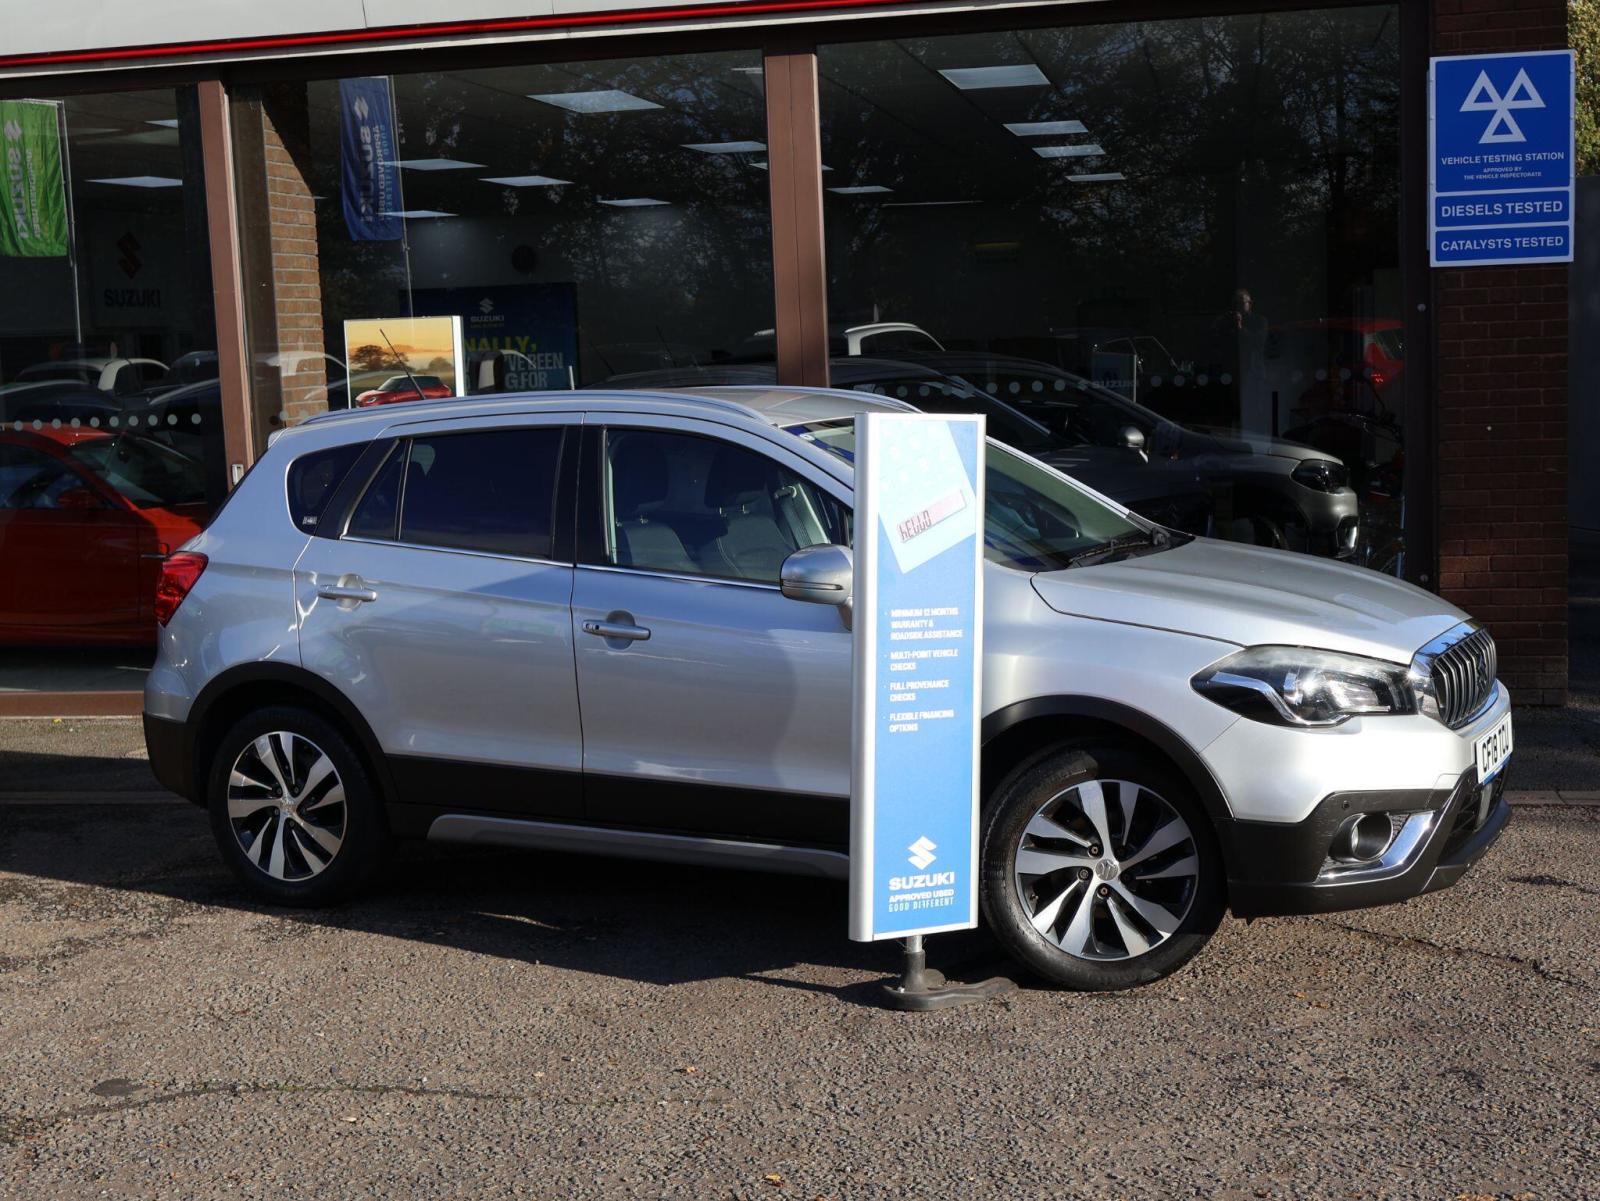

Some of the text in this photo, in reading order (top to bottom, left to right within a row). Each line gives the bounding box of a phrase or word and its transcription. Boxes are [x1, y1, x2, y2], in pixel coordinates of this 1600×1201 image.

[1441, 151, 1565, 165] VEHICLE TESTING STATION
[1500, 171, 1542, 179] INSPECTORATE
[1441, 200, 1563, 217] DIESELS TESTED
[1441, 236, 1564, 251] CATALYSTS TESTED
[104, 288, 161, 308] SUZUKI
[470, 314, 505, 322] SUZUKI
[890, 608, 922, 617] MINIMUM
[931, 607, 958, 616] MONTHS
[890, 648, 959, 659] MULTI-POINT VEHICLE
[890, 662, 916, 671] CHECKS
[890, 682, 906, 690] FULL
[890, 693, 916, 702] CHECKS
[889, 712, 920, 721] FLEXIBLE
[889, 723, 918, 732] OPTIONS
[889, 871, 955, 891] SUZUKI
[889, 889, 955, 902] APPROVED USED
[888, 897, 954, 912] GOOD DIFFERENT
